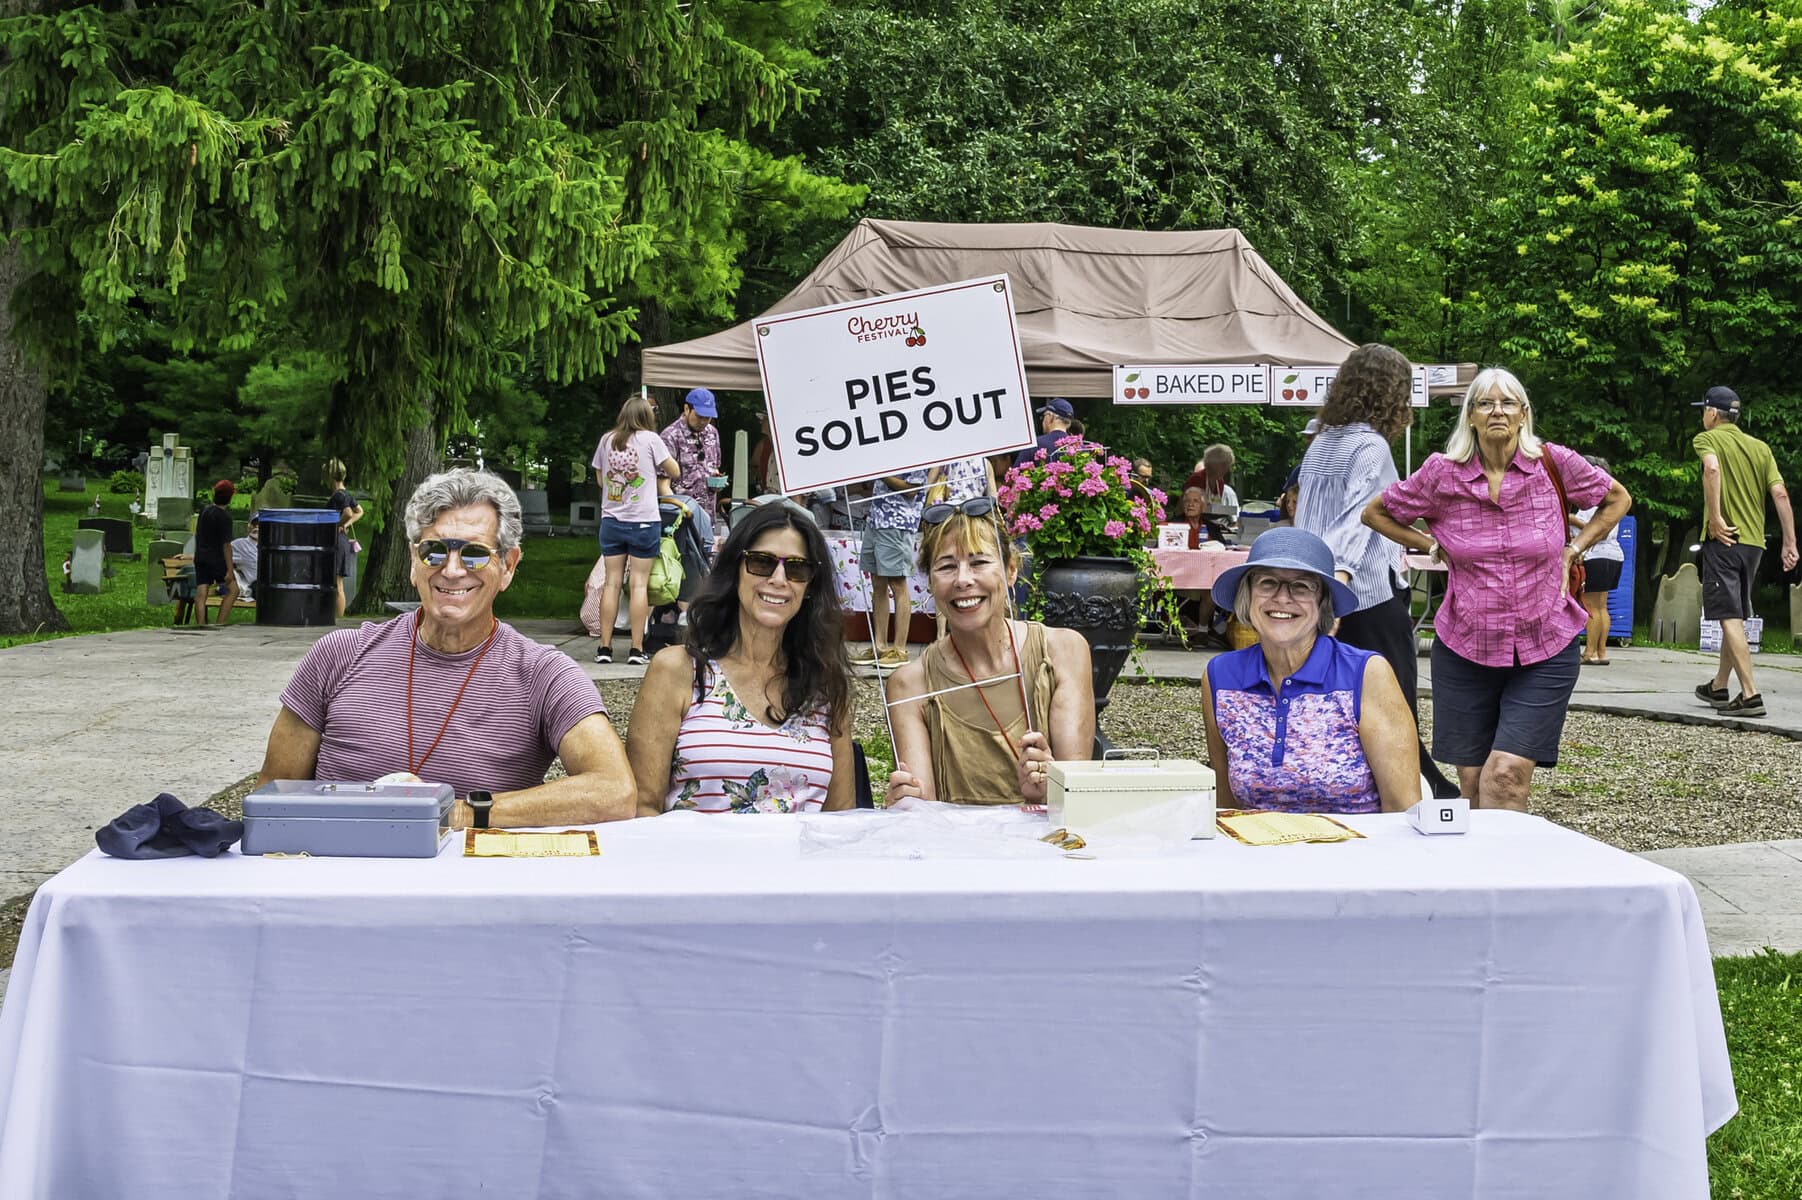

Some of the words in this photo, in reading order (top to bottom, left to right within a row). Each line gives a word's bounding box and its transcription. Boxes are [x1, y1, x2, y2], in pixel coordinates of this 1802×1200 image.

[848, 312, 919, 335] Cherry
[857, 328, 909, 343] FESTIVAL
[845, 366, 936, 410] PIES
[1156, 374, 1225, 394] BAKED
[1231, 374, 1264, 393] PIE
[795, 409, 908, 457] SOLD
[922, 388, 1007, 431] OUT
